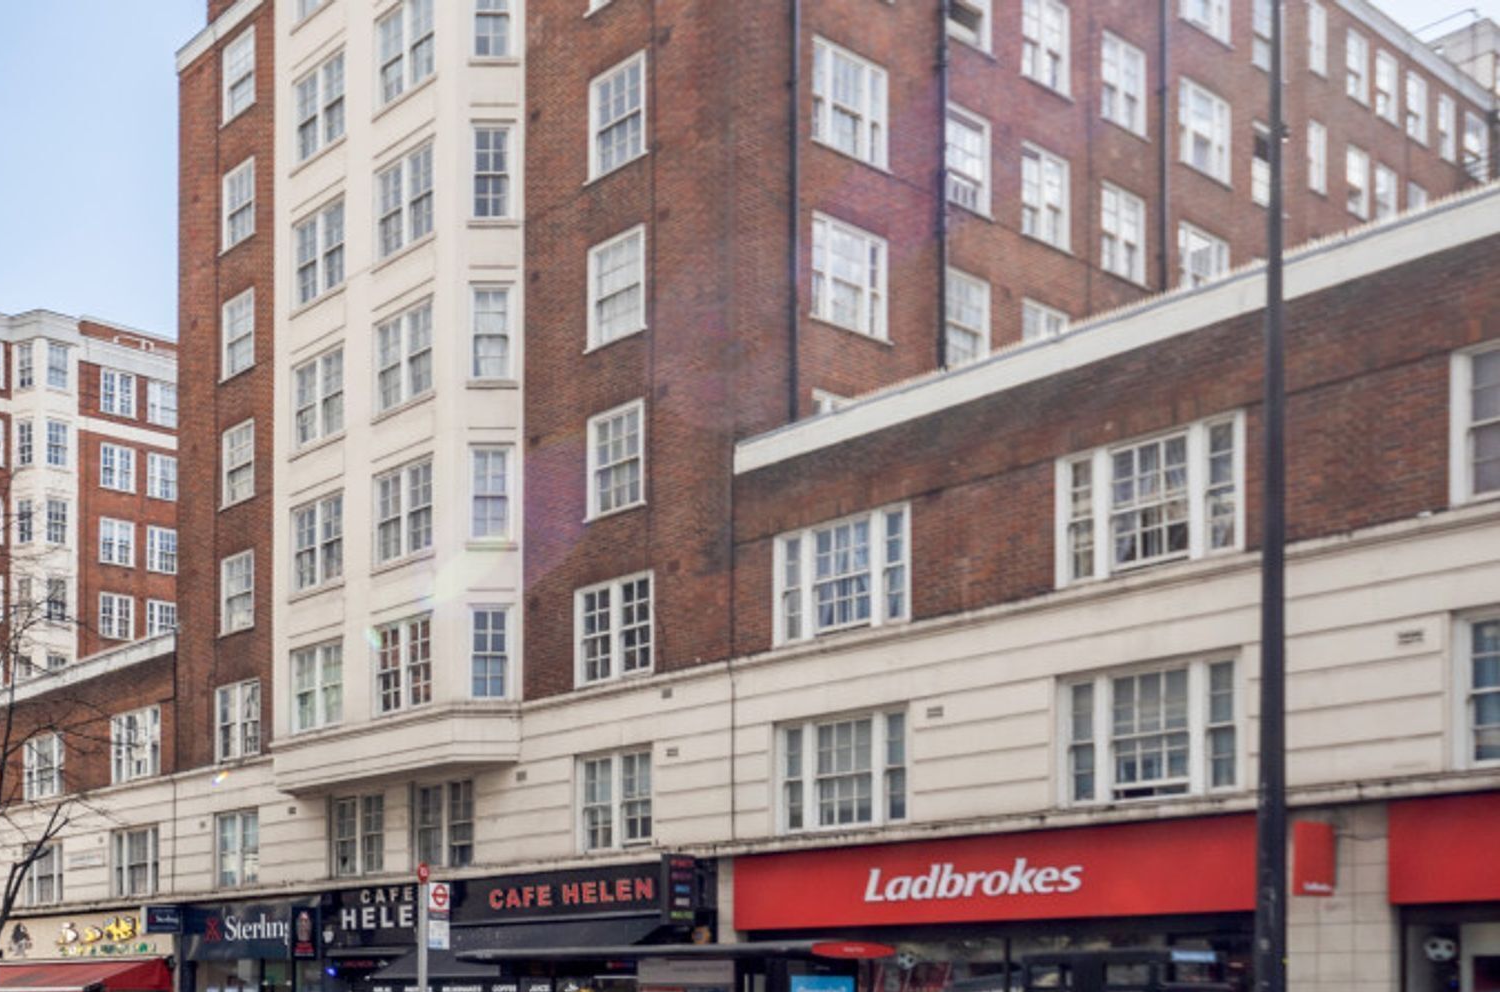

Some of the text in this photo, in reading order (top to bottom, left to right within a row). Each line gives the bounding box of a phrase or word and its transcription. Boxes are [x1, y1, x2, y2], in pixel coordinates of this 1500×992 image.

[489, 877, 654, 910] CAFE HELEN
[864, 857, 1083, 902] Ladbrokes
[361, 887, 414, 904] CAFE
[341, 904, 414, 930] HELE
